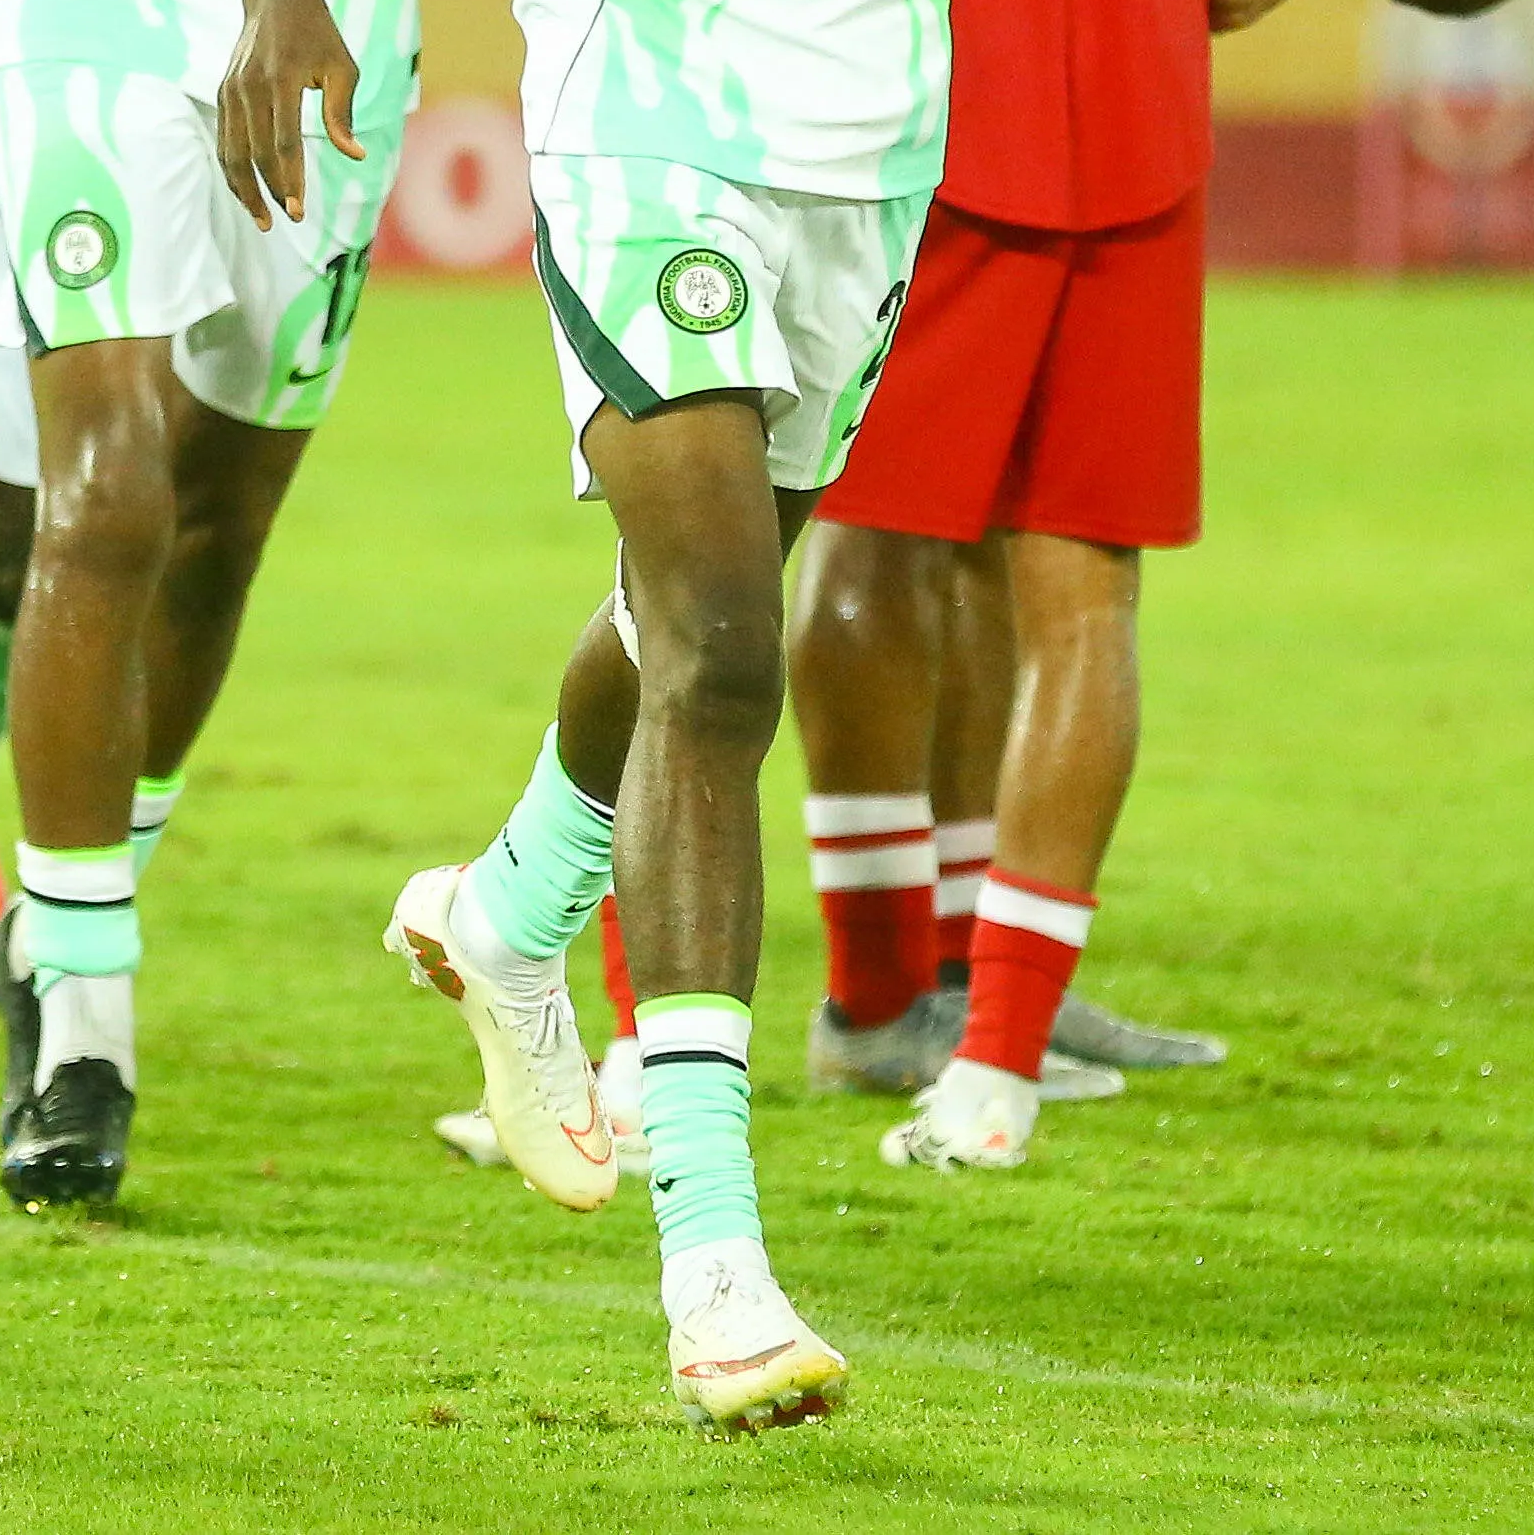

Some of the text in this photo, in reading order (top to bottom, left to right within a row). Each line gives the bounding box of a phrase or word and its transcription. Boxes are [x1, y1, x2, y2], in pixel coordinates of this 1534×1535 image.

[663, 255, 743, 322] NIGERIA FOOTBALL FEDERATION
[699, 318, 722, 328] 1945
